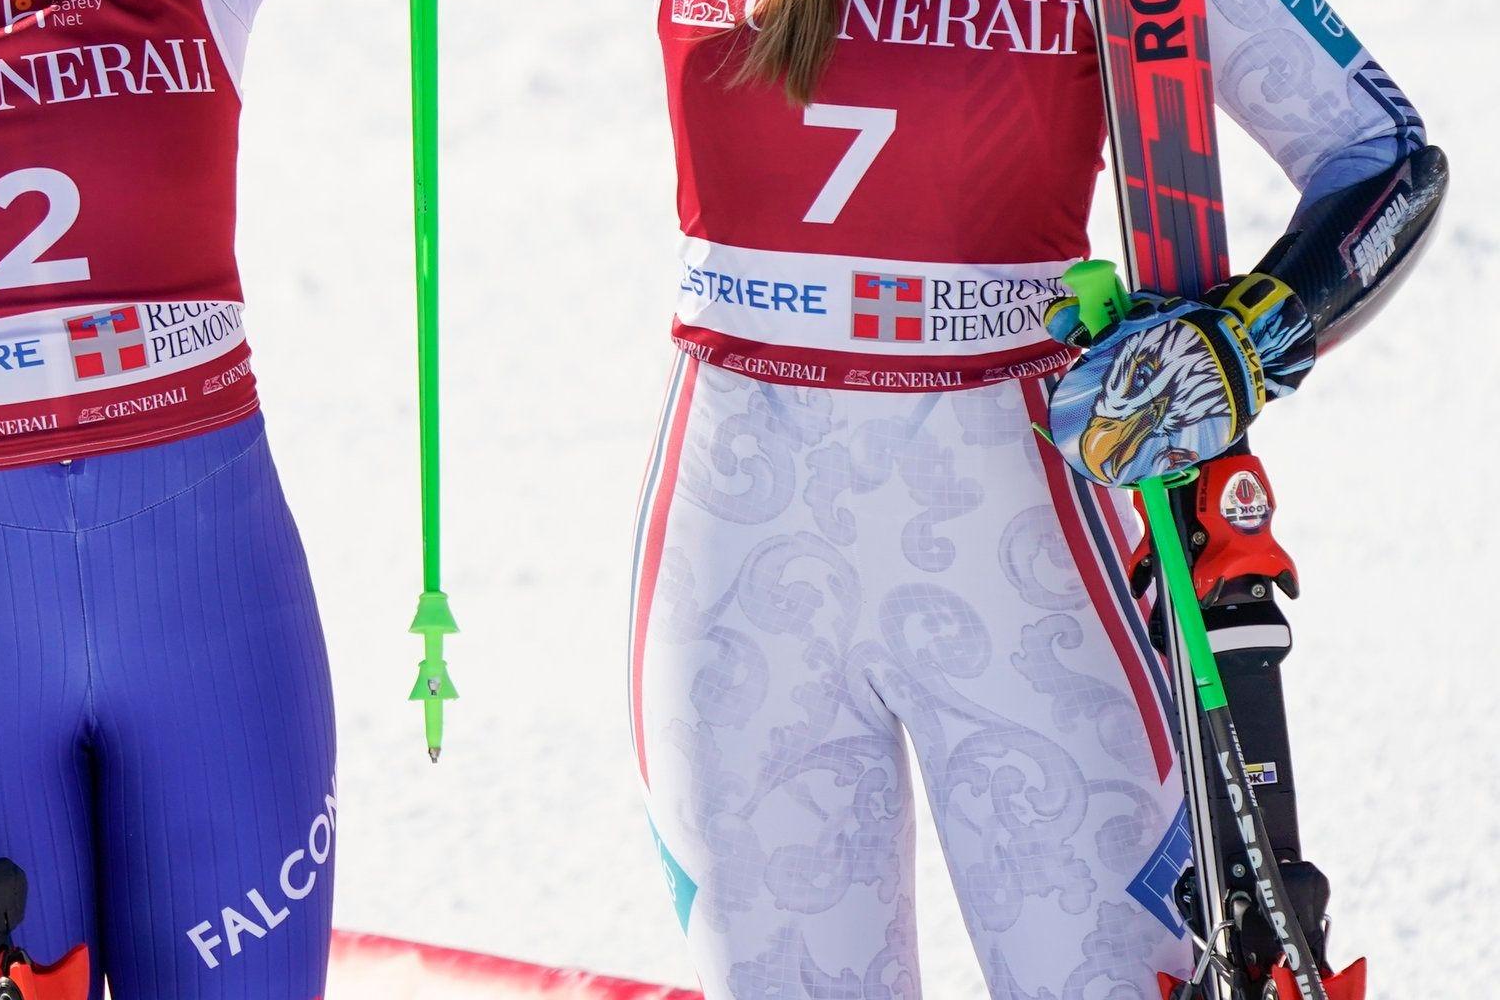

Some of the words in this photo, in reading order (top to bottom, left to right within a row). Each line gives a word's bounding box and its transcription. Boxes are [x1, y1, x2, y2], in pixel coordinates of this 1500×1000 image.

[53, 13, 84, 28] Net
[802, 103, 898, 225] 7
[745, 357, 827, 383] GENERALI
[1232, 324, 1264, 400] LEVEL
[871, 371, 963, 387] GENERALI
[105, 387, 188, 418] GENERALI
